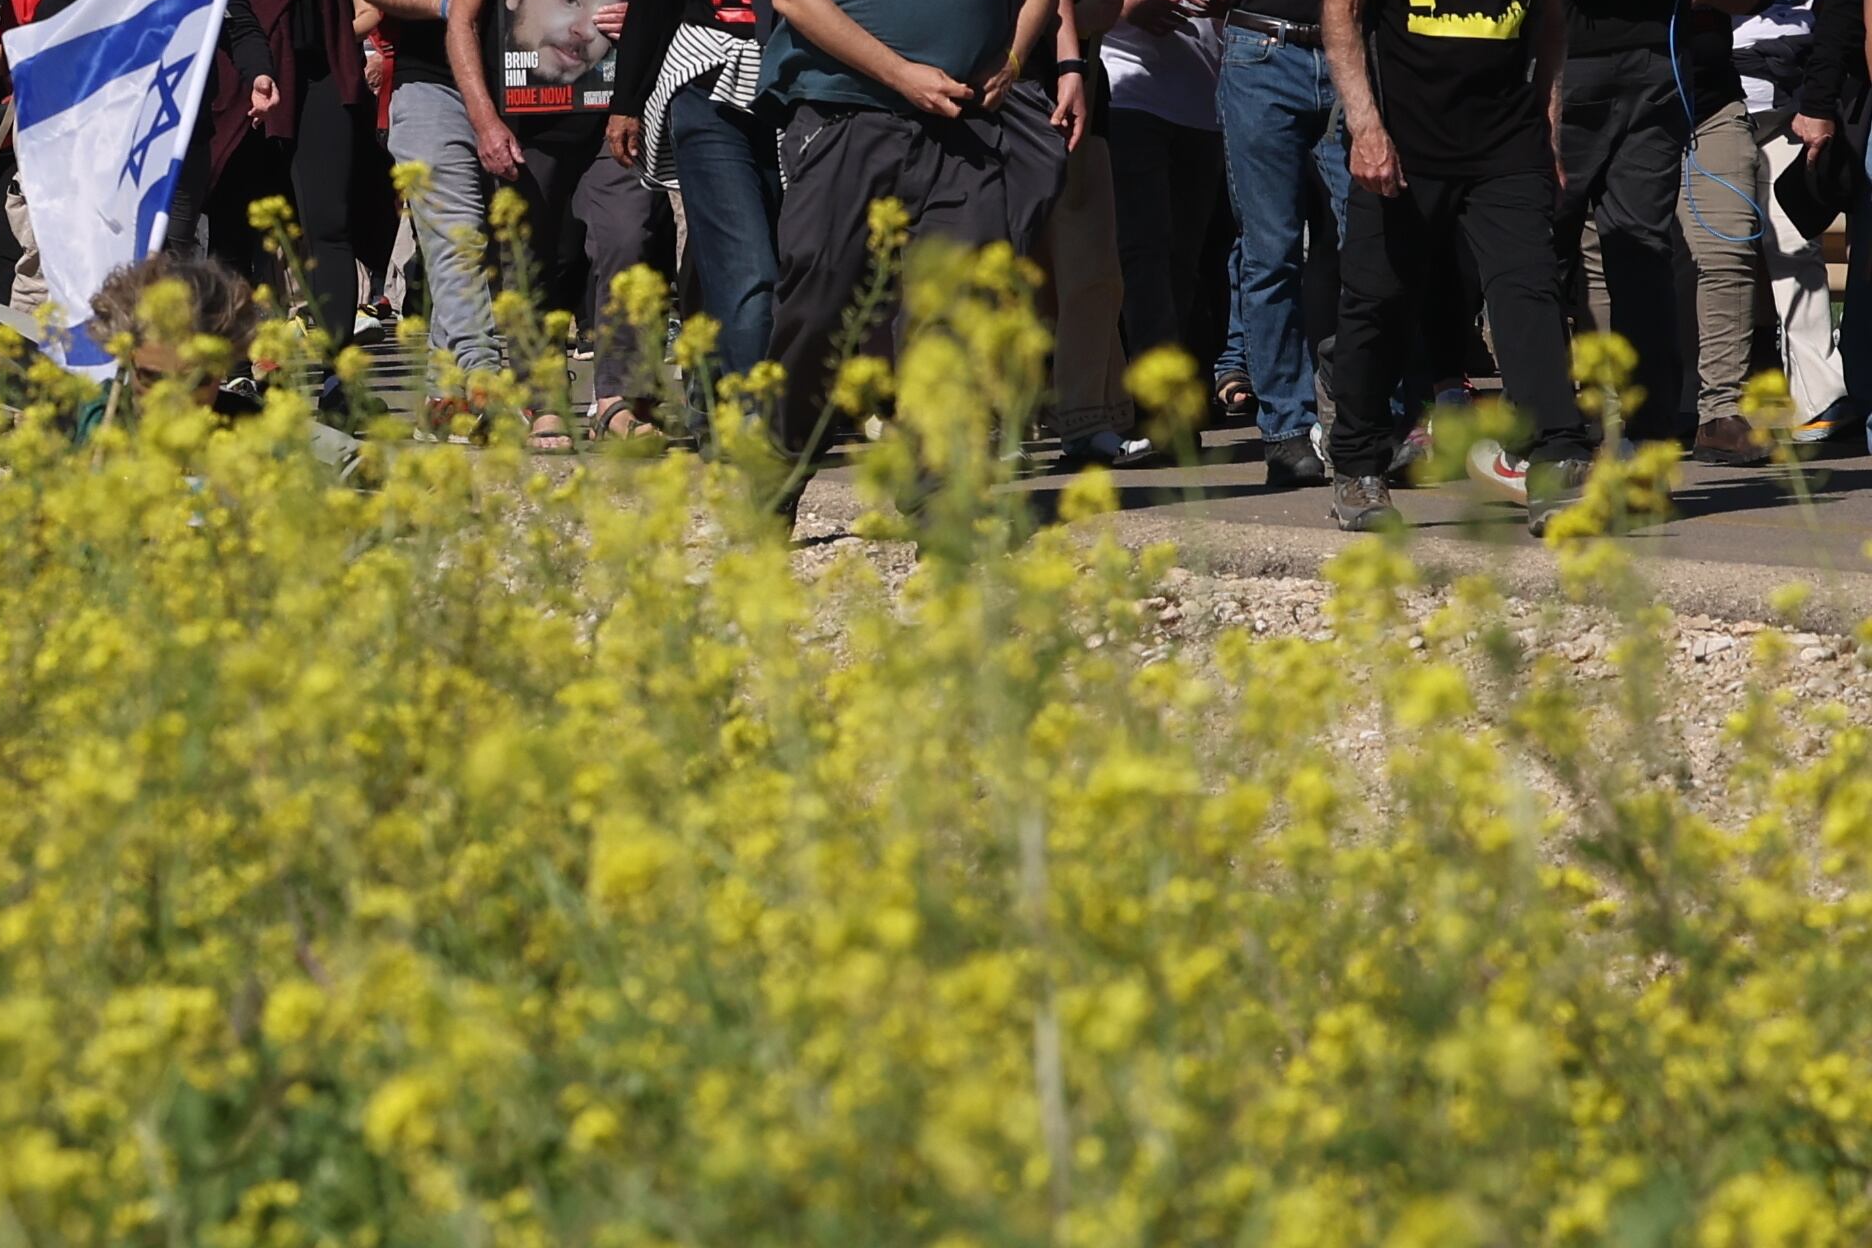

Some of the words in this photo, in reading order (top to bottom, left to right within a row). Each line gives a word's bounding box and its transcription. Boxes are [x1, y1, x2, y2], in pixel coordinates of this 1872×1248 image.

[504, 51, 539, 68] BRING
[505, 69, 527, 86] HIM
[505, 88, 536, 105] HOME
[540, 85, 573, 105] NOW!
